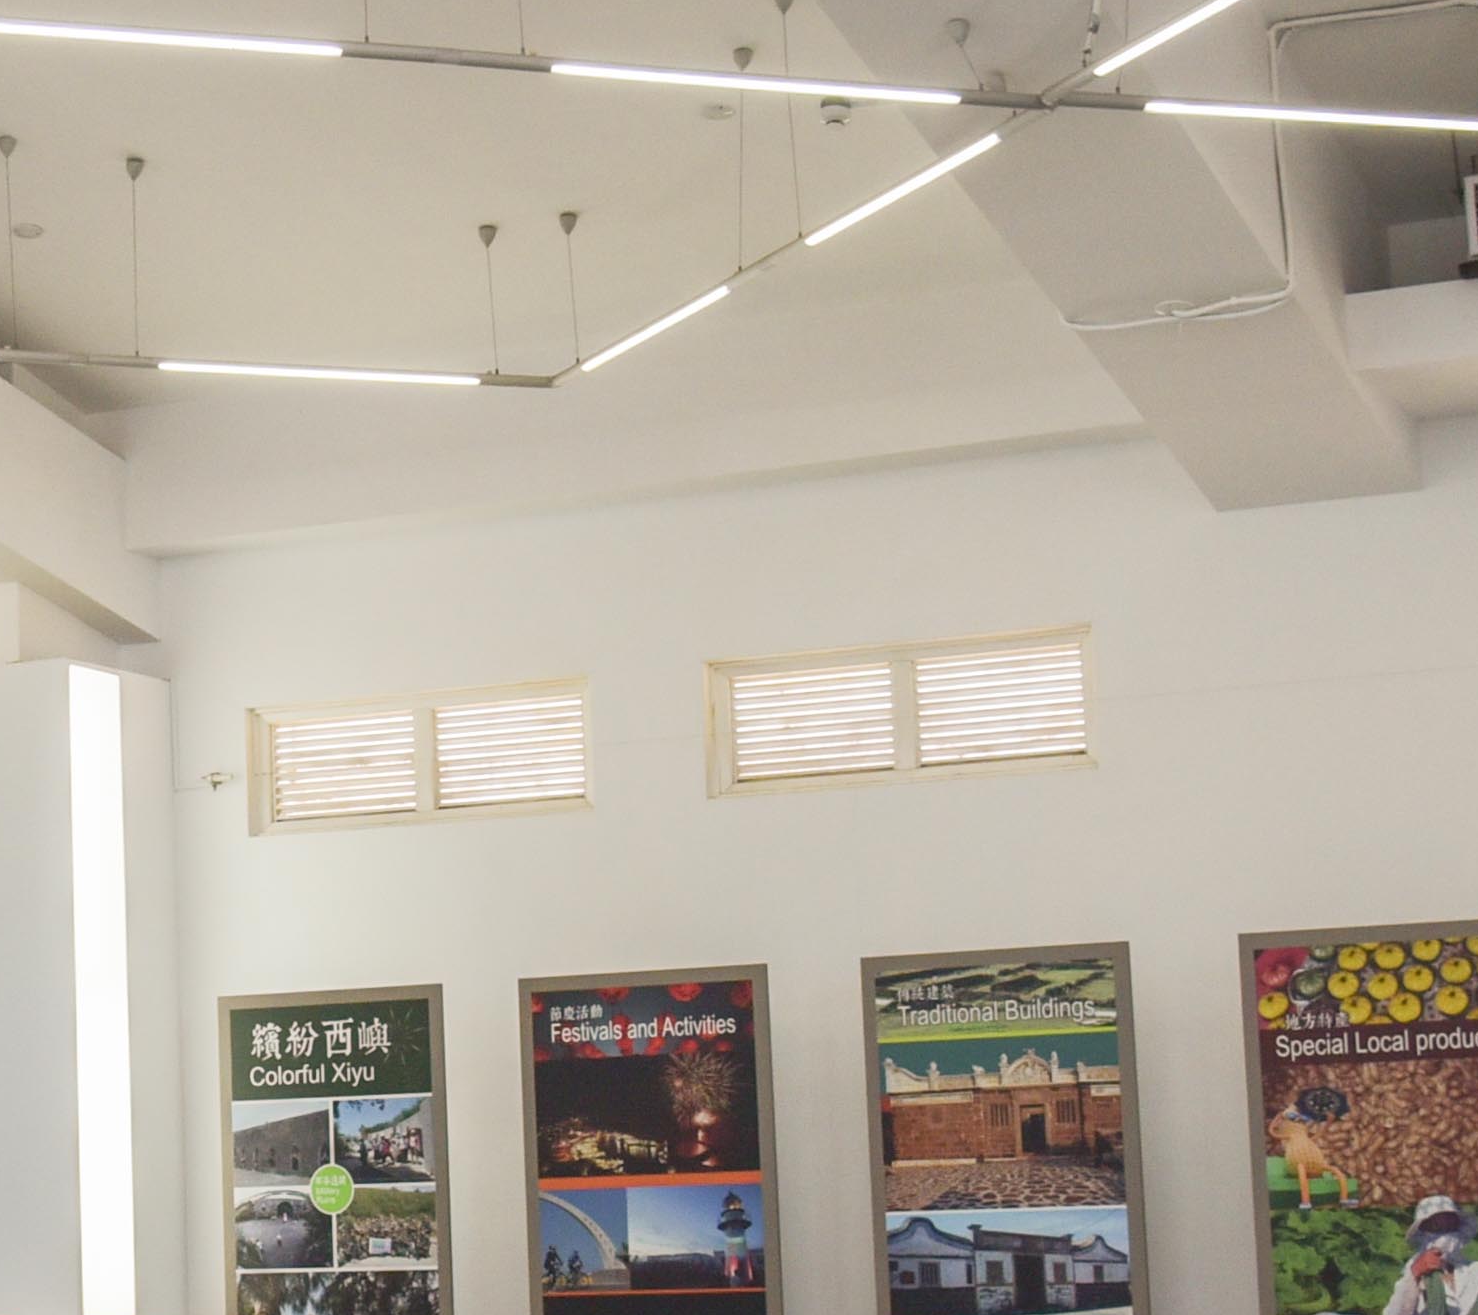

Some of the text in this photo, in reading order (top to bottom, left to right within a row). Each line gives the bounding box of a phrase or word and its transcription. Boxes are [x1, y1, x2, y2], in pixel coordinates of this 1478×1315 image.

[549, 1003, 603, 1022] 節慶活動
[898, 997, 1095, 1026] Traditional Buildings
[250, 1016, 392, 1061] 繽紛西嶼
[551, 1013, 736, 1044] Festivals and Activities
[1275, 1032, 1349, 1062] Special
[1354, 1030, 1409, 1054] Local
[249, 1062, 375, 1087] Colorful Xiyu
